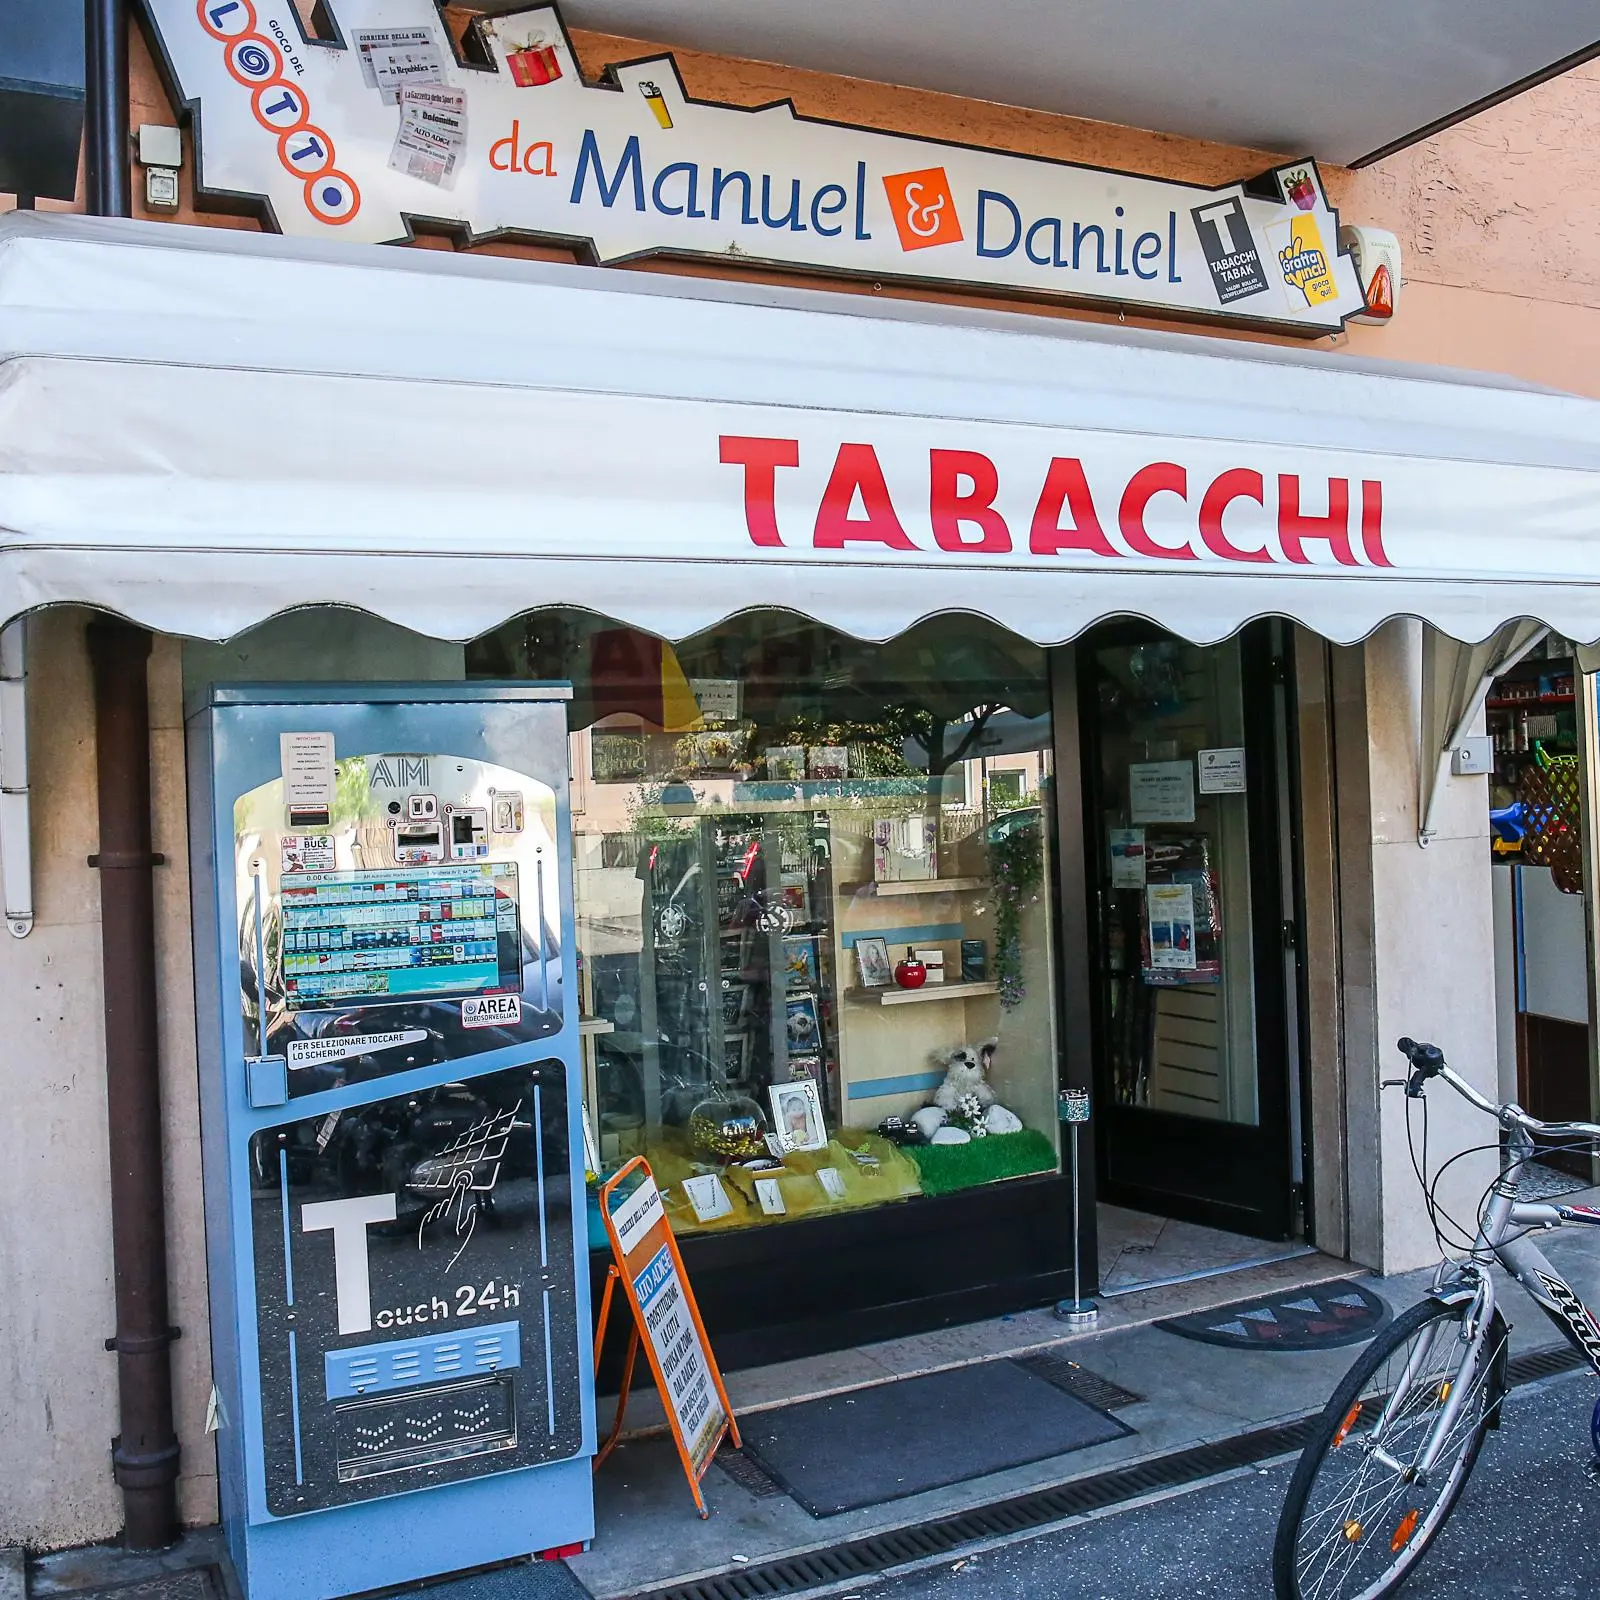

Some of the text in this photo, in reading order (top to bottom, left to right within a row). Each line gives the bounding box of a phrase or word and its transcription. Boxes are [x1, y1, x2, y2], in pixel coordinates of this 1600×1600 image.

[268, 18, 306, 77] GIOCO DEL
[414, 127, 432, 139] ALTO
[489, 119, 1182, 283] da Manuel & Daniel
[1199, 201, 1236, 256] T
[1210, 250, 1257, 273] TABACCHI
[1283, 252, 1317, 273] Gratta
[1220, 263, 1255, 284] TABAK
[1312, 279, 1330, 292] gioca
[1320, 286, 1333, 298] qui!
[718, 434, 1397, 568] TABACCHI
[306, 874, 322, 882] 0.00
[478, 997, 517, 1015] AREA
[463, 1011, 519, 1023] VIDEOSORVEGLIATA
[292, 1033, 405, 1051] PER SELEZIONARE TOCCARE
[293, 1048, 346, 1061] LO SCHERMO
[635, 1251, 672, 1304] ALTO ADIGE
[455, 1280, 520, 1318] 24h
[646, 1281, 679, 1334] PROSTITUZIONE
[660, 1328, 670, 1349] LA
[662, 1326, 694, 1380] DIVISA IN ZONE
[672, 1352, 699, 1399] DAL RACKET
